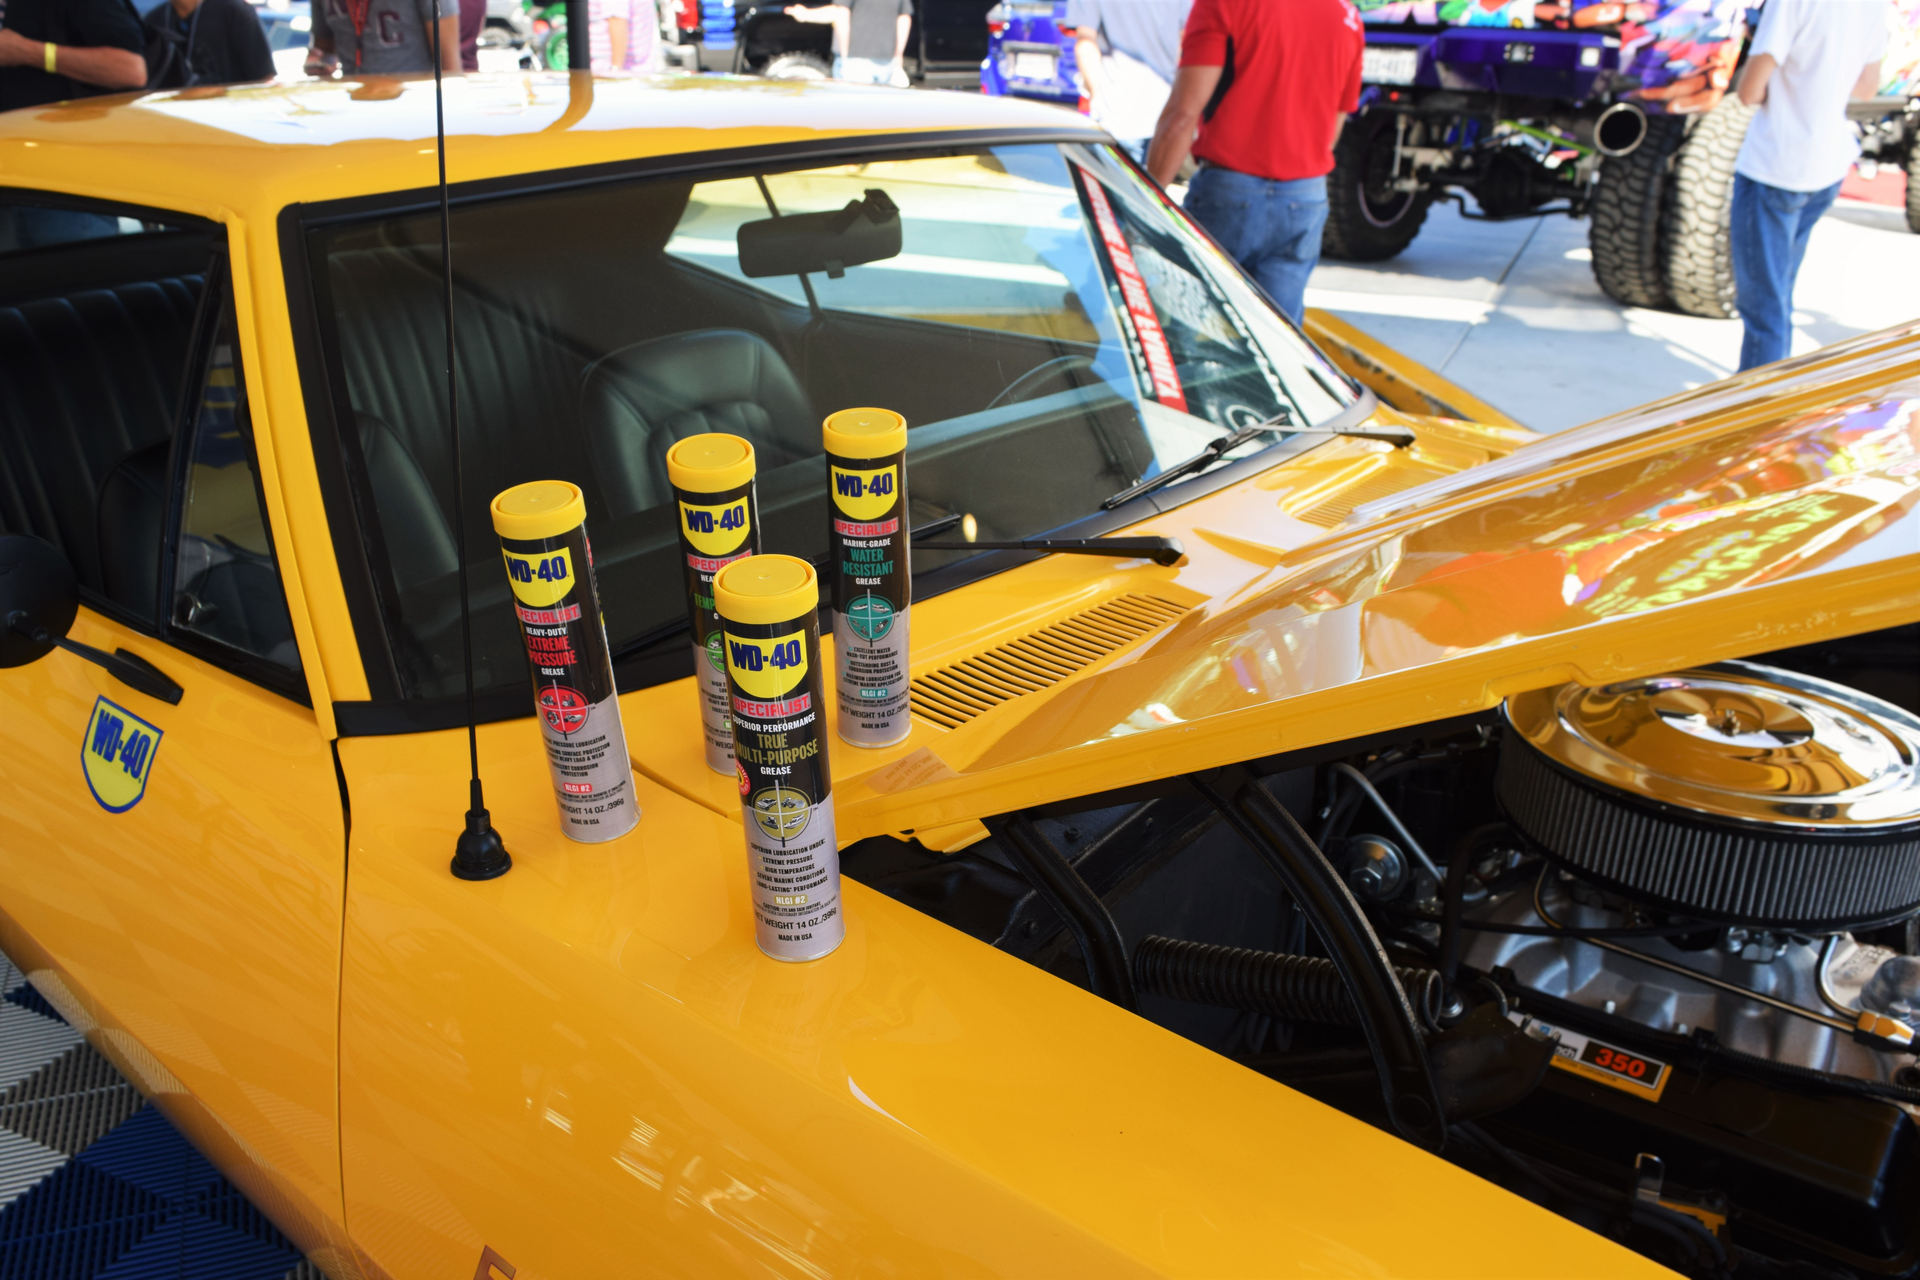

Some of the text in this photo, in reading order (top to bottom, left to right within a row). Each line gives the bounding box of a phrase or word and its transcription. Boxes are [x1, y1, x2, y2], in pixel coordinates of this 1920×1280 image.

[835, 471, 893, 498] WD-40
[684, 505, 745, 533] WD-40
[834, 519, 898, 536] SPECIALIST
[842, 538, 891, 548] MARINE-GRADE
[850, 548, 884, 562] WATER
[505, 555, 567, 584] WD-40
[842, 560, 894, 577] RESISTANT
[855, 577, 881, 585] GREASE
[526, 626, 567, 636] HEAVY-DUTY
[527, 635, 571, 650] EXTREME
[530, 650, 577, 667] PRESSURE
[729, 639, 801, 672] WD-40
[541, 667, 565, 676] GREASE
[733, 695, 810, 717] SPECIALIST
[850, 709, 875, 718] WEIGHT
[733, 714, 761, 732] SUPERIOR
[763, 712, 816, 732] PERFORMANCE
[91, 708, 151, 779] WD-40
[757, 733, 788, 749] TRUE
[736, 738, 819, 766] MULTI-PURPOSE
[760, 765, 792, 776] GREASE
[773, 846, 808, 856] LUBRICATION
[809, 838, 825, 851] UNDER:
[763, 854, 813, 865] EXTREME PRESSURE
[757, 872, 773, 882] SEVERE
[795, 868, 825, 882] CONDITIONS
[765, 863, 815, 874] HIGH TEMPERATURE
[793, 875, 828, 892] PERFORMANCE
[775, 896, 793, 904] NLGI
[794, 895, 805, 904] #2
[754, 909, 763, 921] NET
[764, 916, 794, 929] WEIGHT
[796, 921, 807, 929] 14
[778, 933, 793, 941] MADE
[801, 933, 813, 941] USA
[1594, 1047, 1647, 1079] 350
